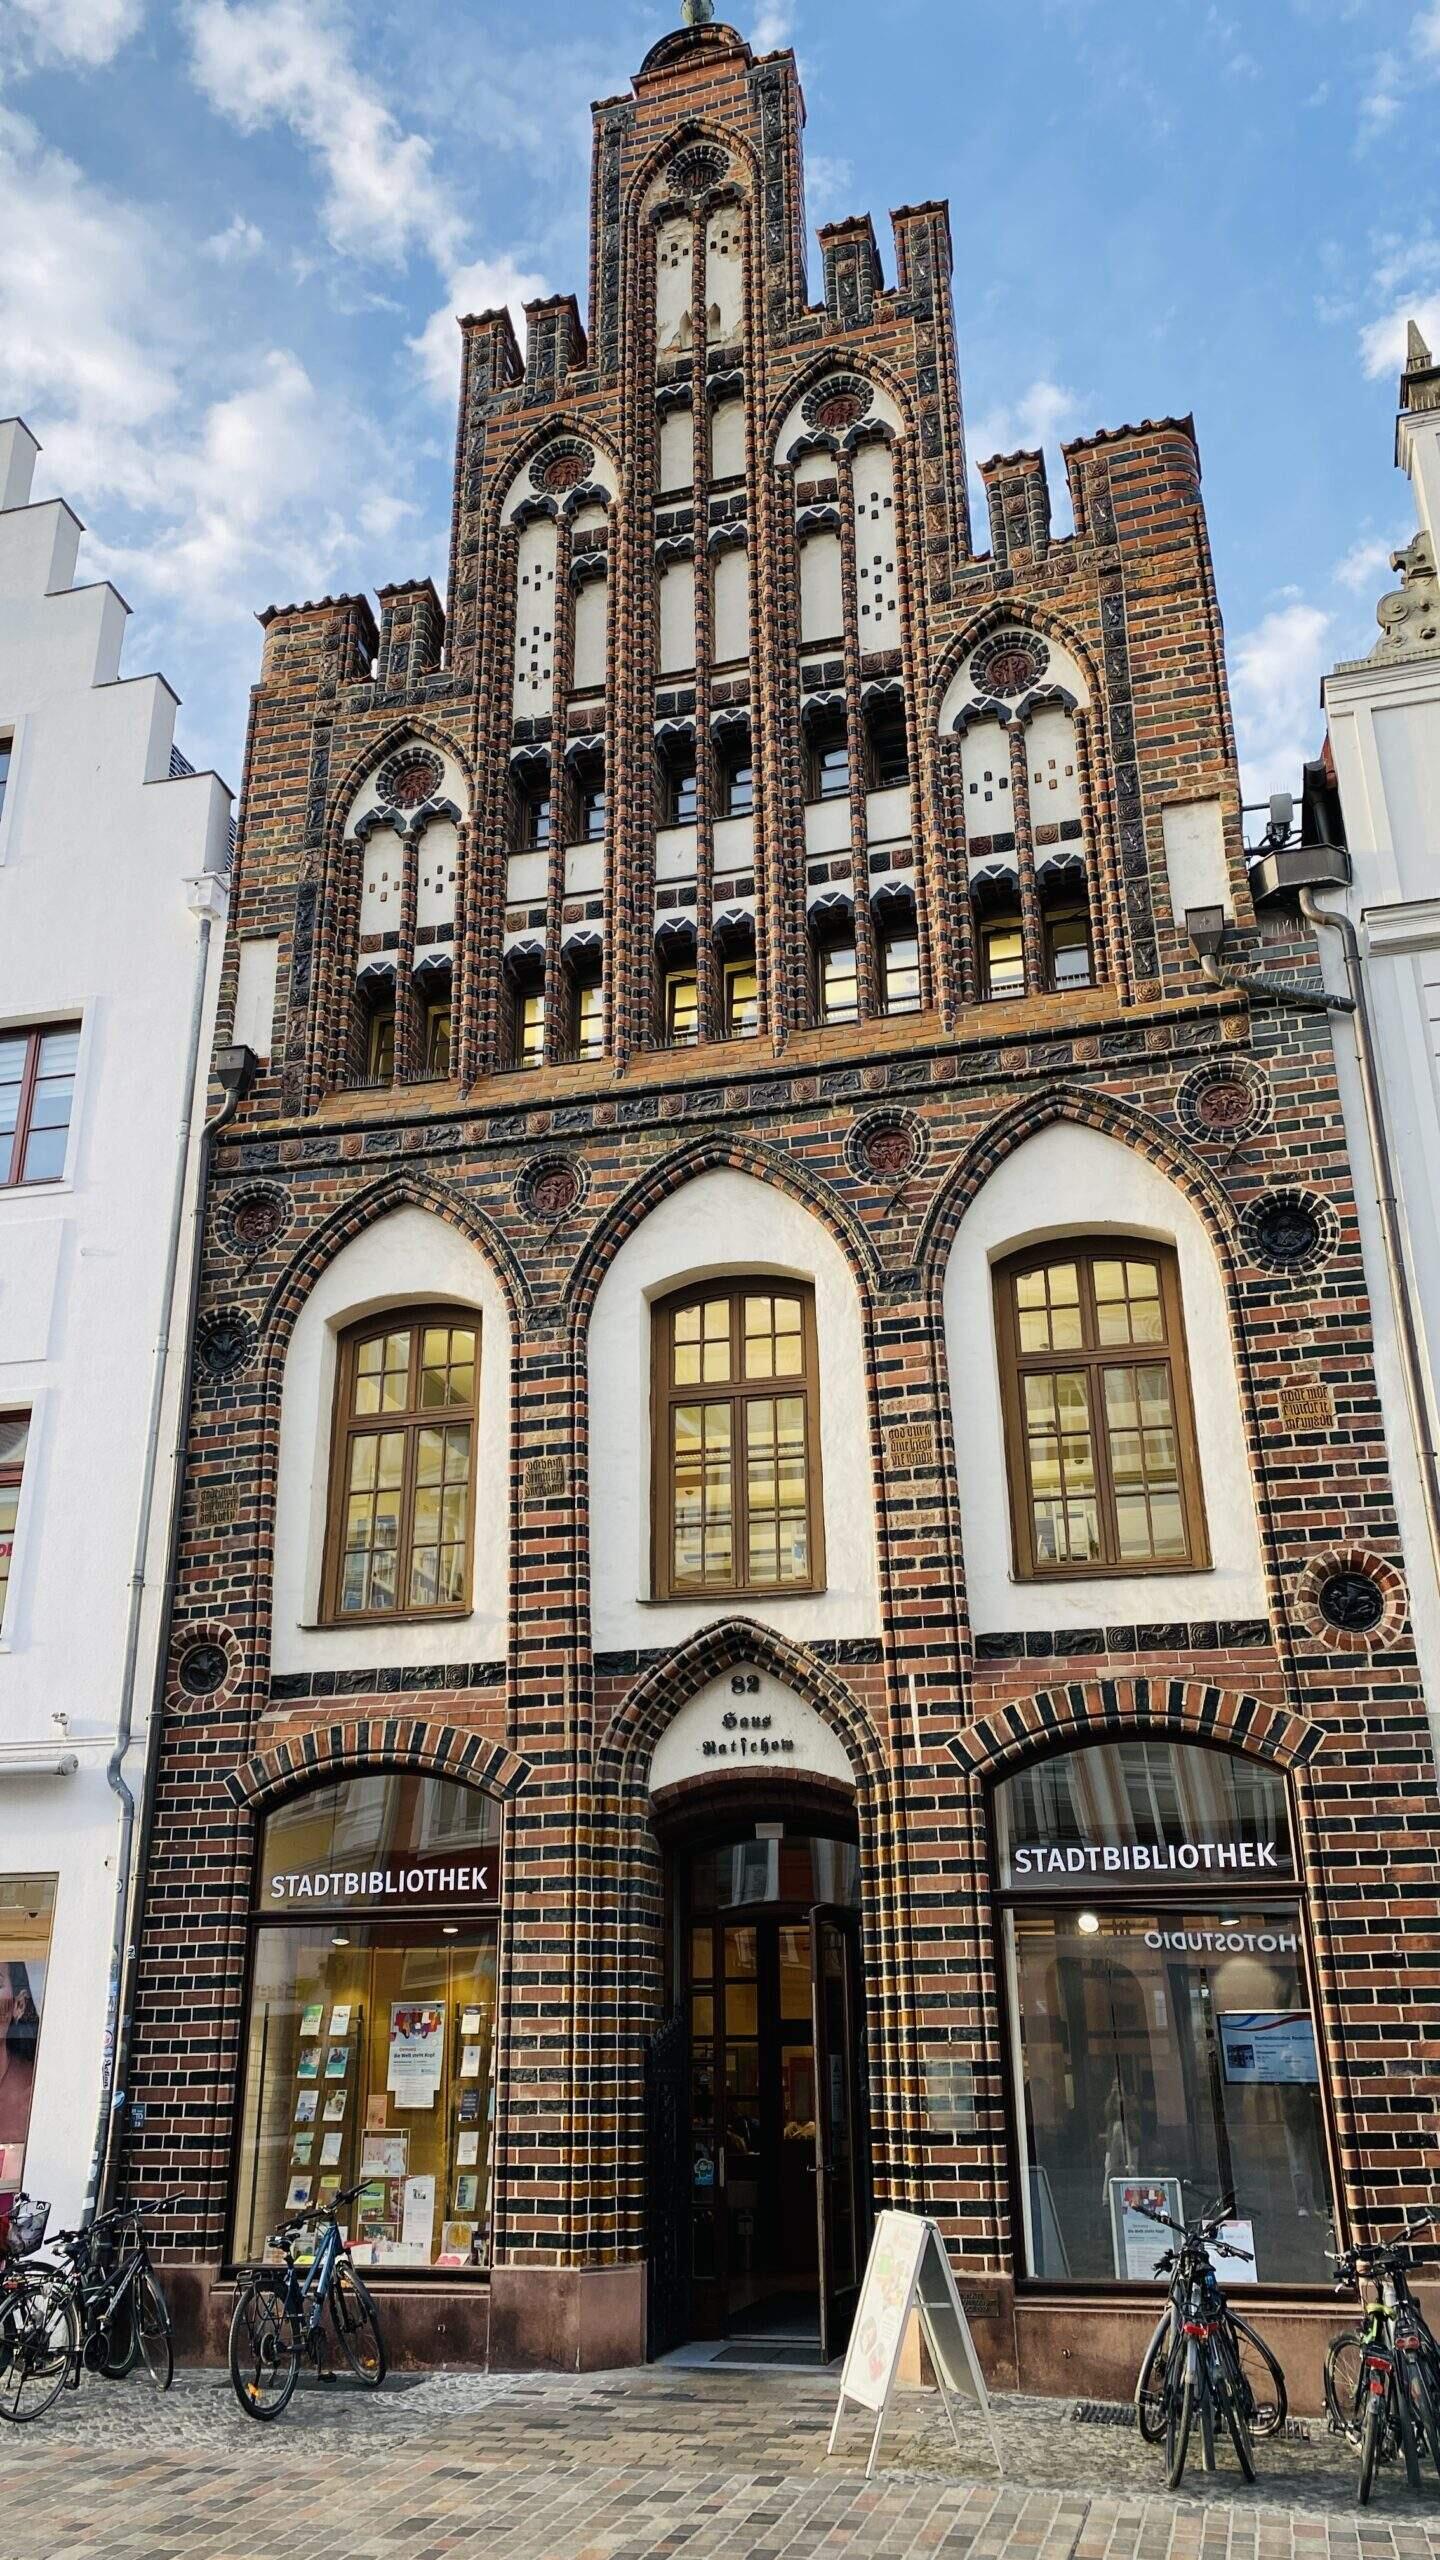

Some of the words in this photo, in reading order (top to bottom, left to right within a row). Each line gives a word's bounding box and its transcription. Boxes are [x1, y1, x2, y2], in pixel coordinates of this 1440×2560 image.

[731, 1675, 760, 1694] 82
[722, 1712, 772, 1730] Haus
[1015, 1841, 1278, 1873] STADTBIBLIOTHEK
[270, 1866, 488, 1898] STADTBIBLIOTHEK
